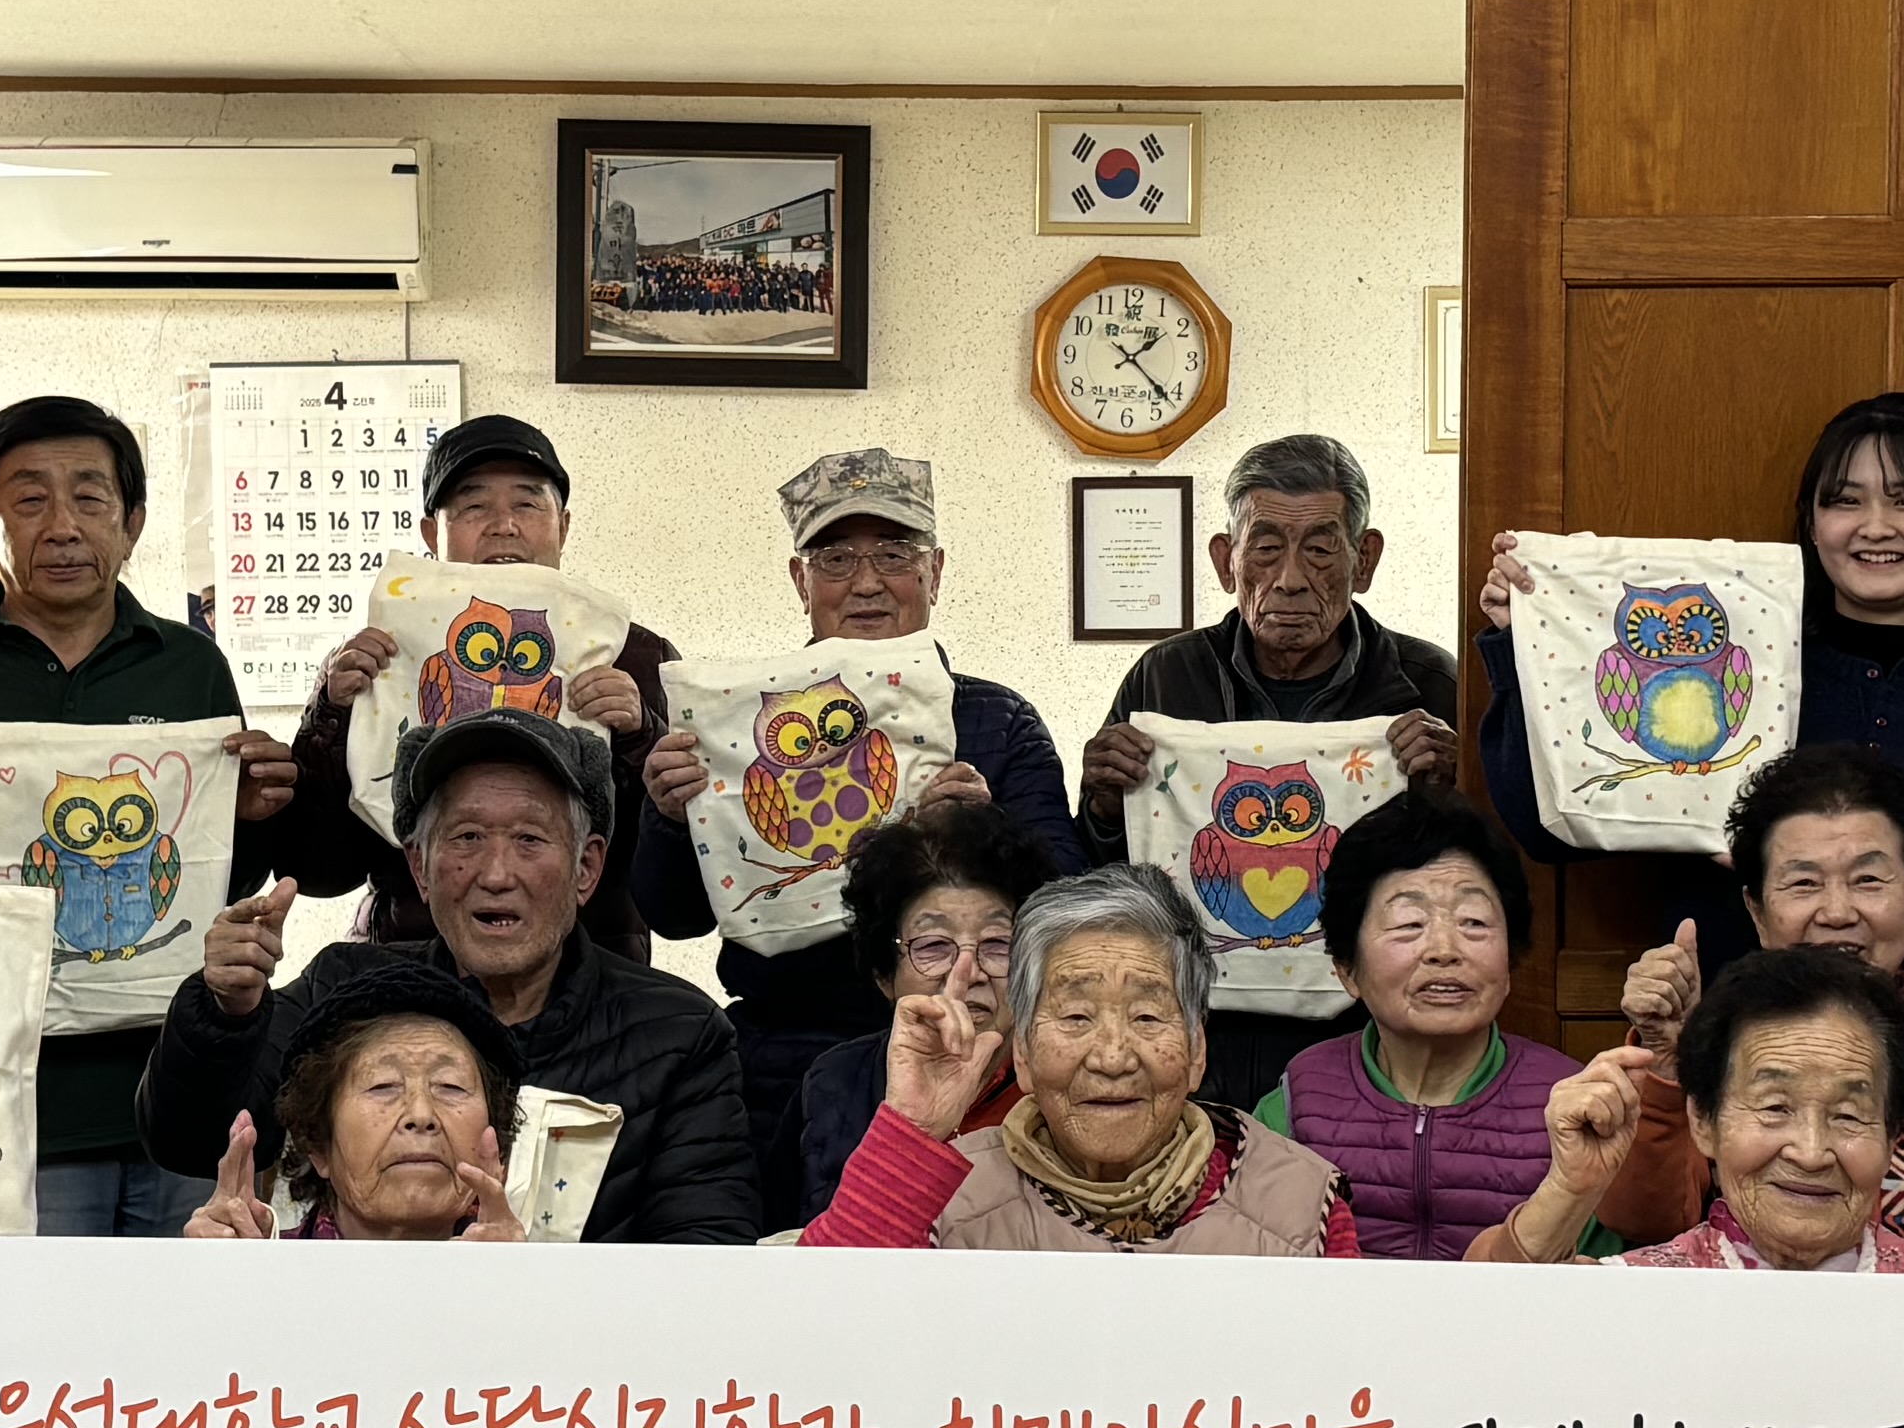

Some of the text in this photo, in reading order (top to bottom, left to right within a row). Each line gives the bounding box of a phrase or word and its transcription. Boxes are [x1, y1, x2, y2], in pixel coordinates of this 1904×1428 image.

[1096, 294, 1114, 316] 11
[1123, 287, 1144, 309] 12
[1157, 297, 1166, 317] 1
[1074, 315, 1093, 336] 10
[1176, 317, 1190, 338] 2
[1063, 344, 1077, 365] 9
[1184, 351, 1198, 372] 3
[324, 381, 348, 411] 4
[1070, 376, 1084, 397] 8
[1170, 381, 1183, 401] 4
[1094, 399, 1108, 420] 7
[1120, 408, 1134, 429] 6
[1149, 401, 1163, 421] 5
[300, 427, 439, 450] 1 2 3 4 5
[235, 468, 408, 491] 6 7 8 9 10 11
[232, 510, 413, 532] 13 14 15 16 17 18
[231, 552, 383, 574] 20 21 22 23 24
[232, 593, 353, 615] 27 28 29 30
